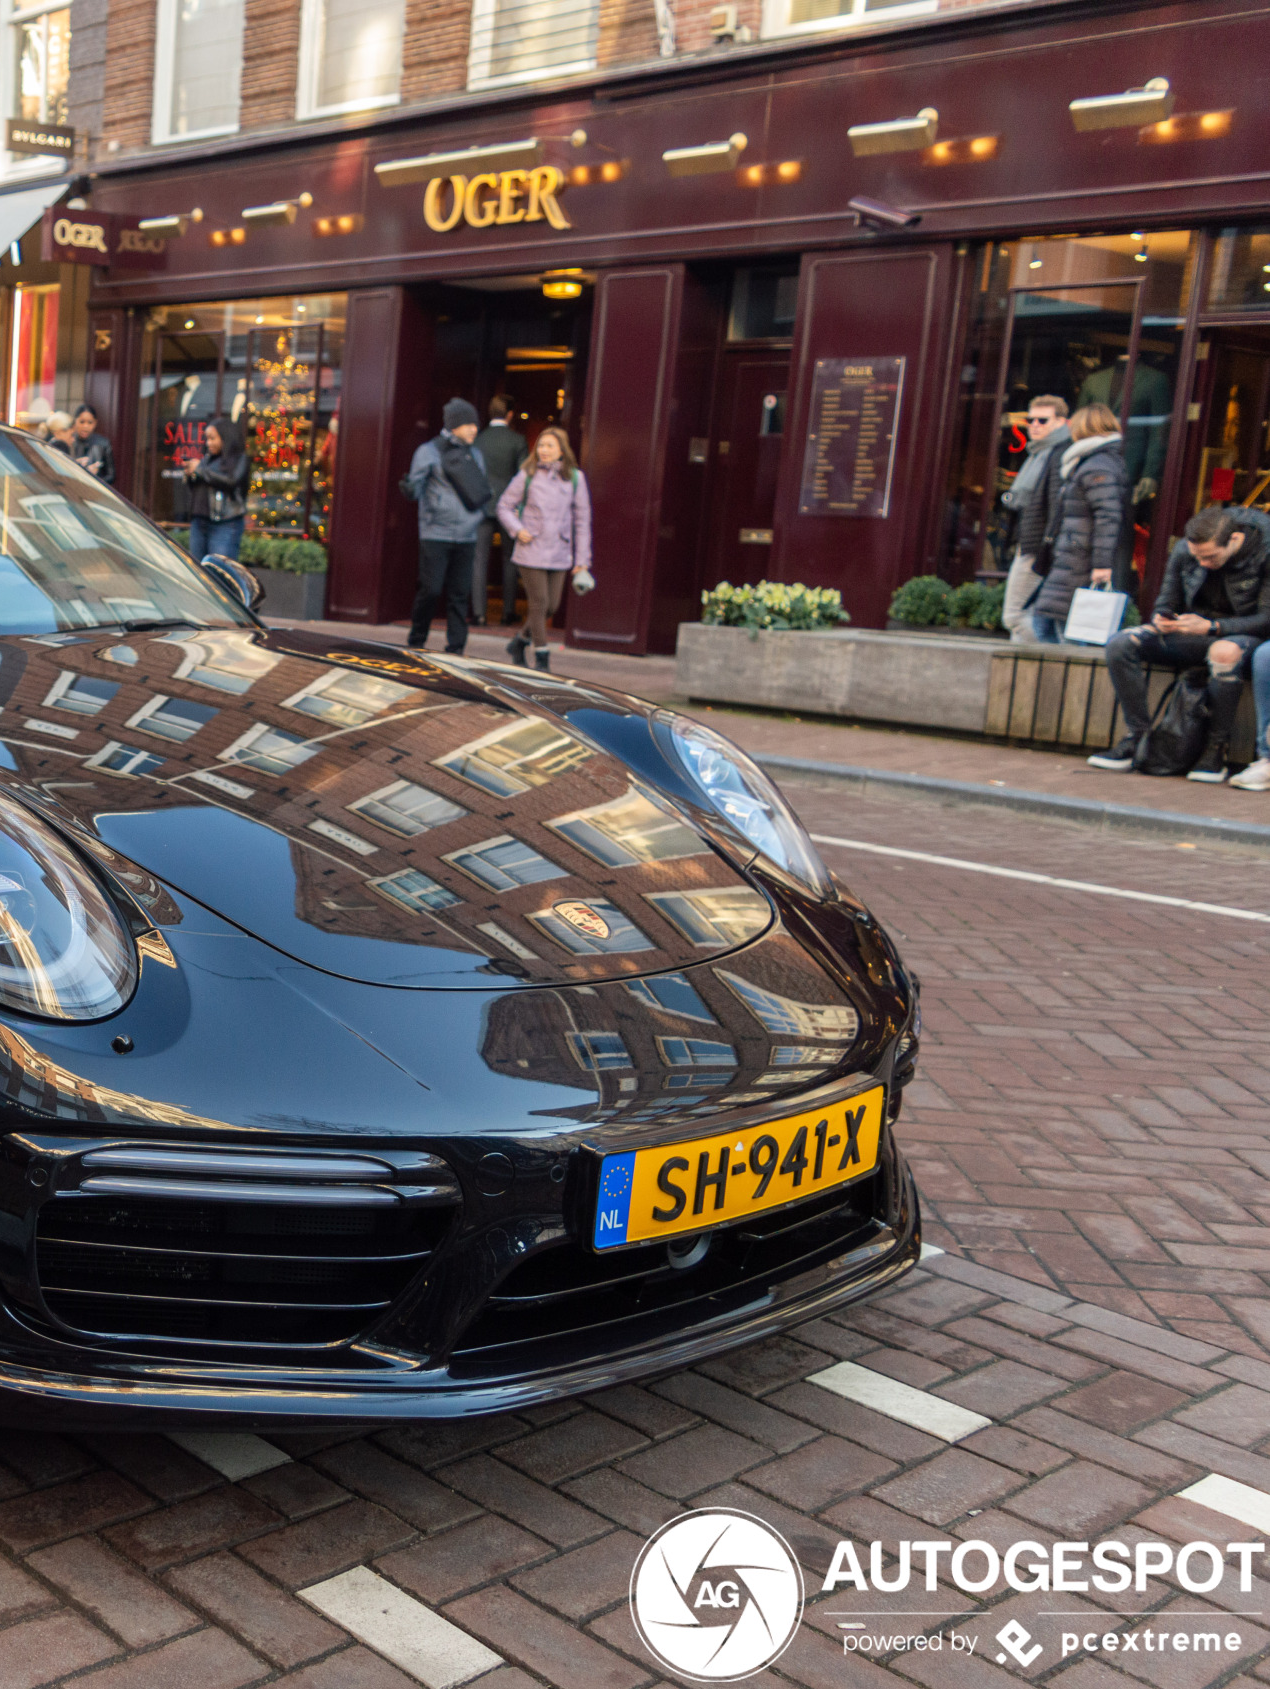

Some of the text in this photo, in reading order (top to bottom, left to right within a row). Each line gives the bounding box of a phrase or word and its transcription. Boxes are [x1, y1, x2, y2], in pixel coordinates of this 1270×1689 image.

[423, 166, 572, 233] OGER
[53, 218, 108, 253] OGER
[163, 421, 208, 445] SALE
[255, 420, 302, 445] SALE
[651, 1104, 867, 1222] SH-941-X
[599, 1208, 624, 1231] NL
